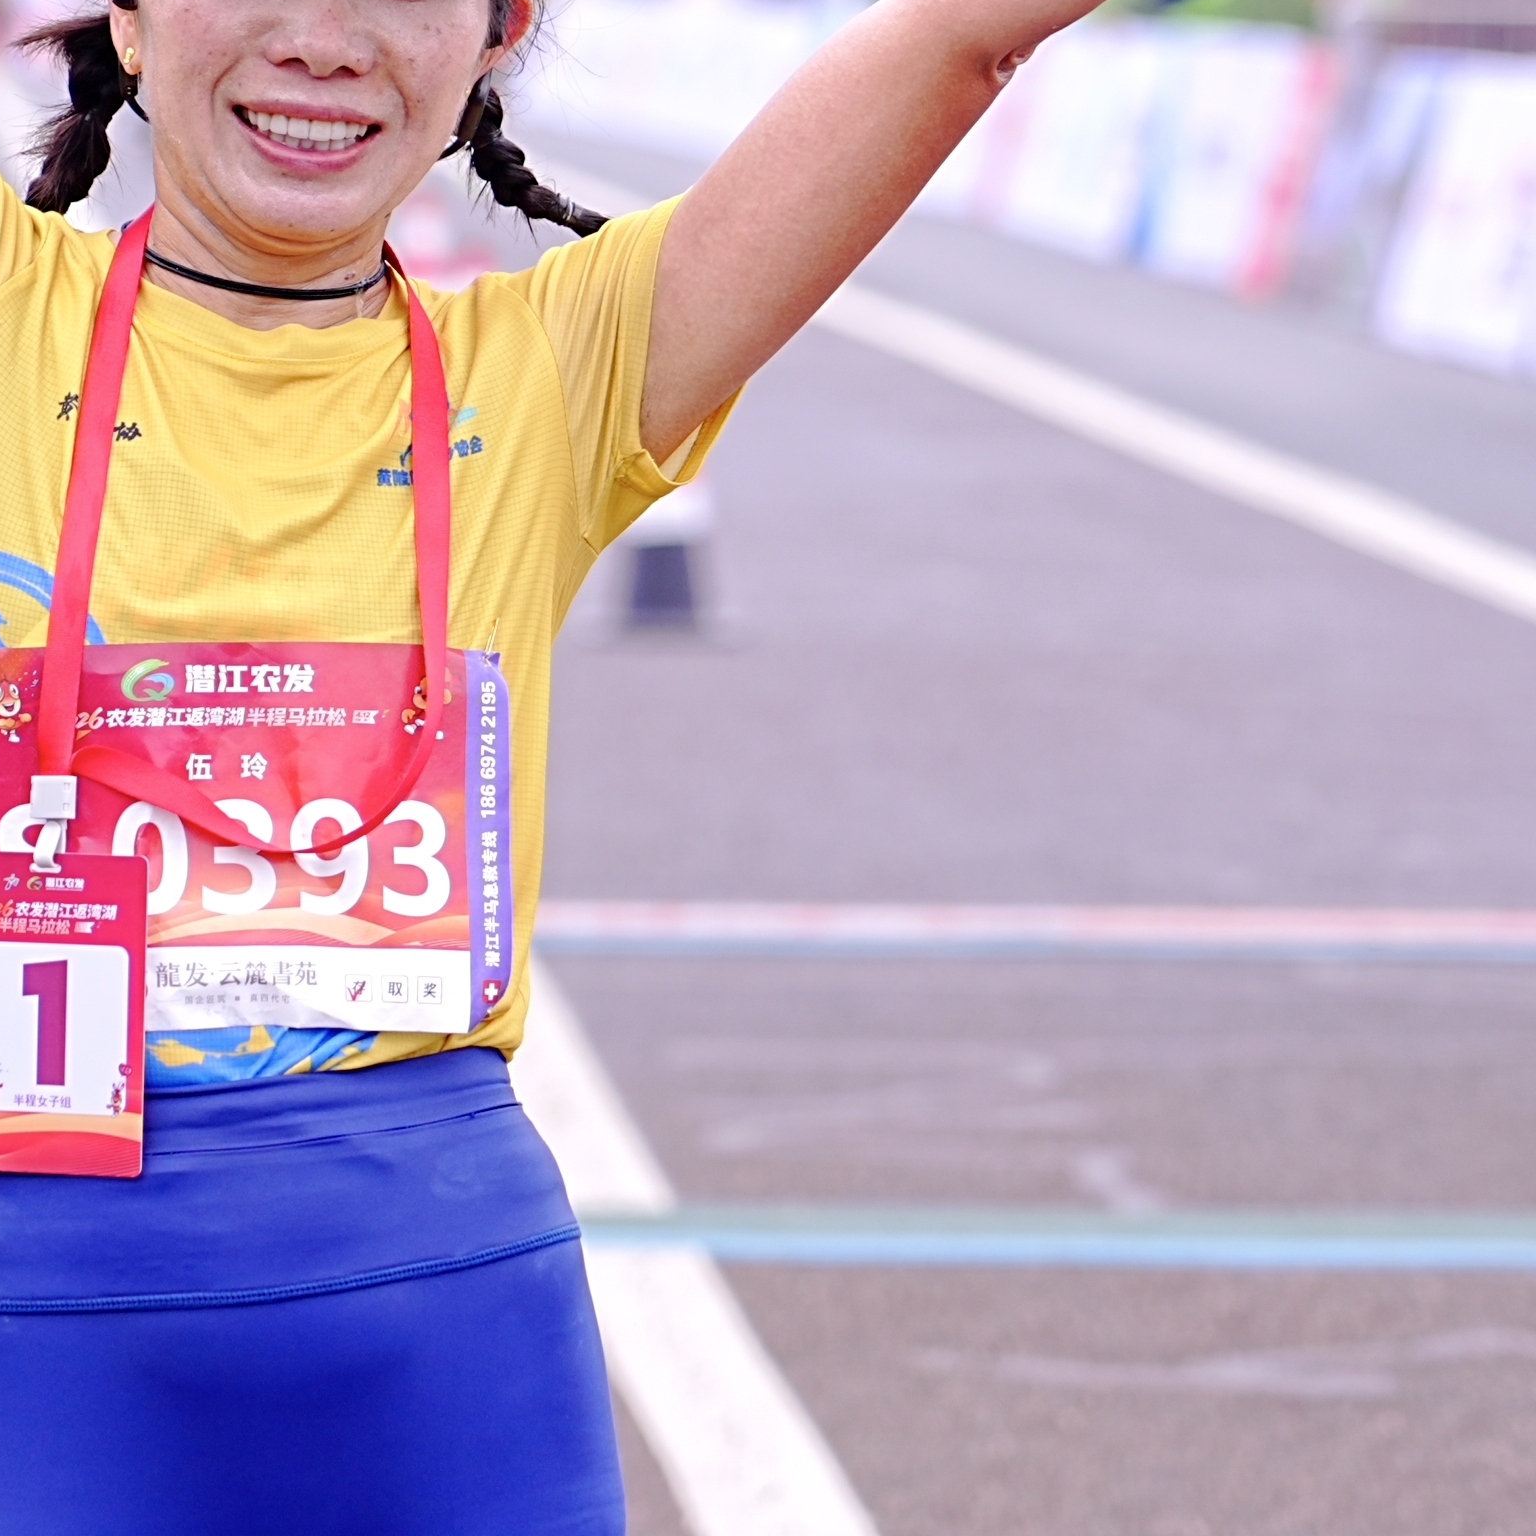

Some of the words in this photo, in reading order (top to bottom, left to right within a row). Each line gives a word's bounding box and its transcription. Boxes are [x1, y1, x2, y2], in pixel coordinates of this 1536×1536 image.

[185, 663, 314, 693] 潜江农发
[480, 681, 497, 728] 2195
[480, 732, 497, 779] 6974
[480, 784, 497, 818] 186
[482, 830, 500, 967] 潜江半马急救专线
[388, 981, 402, 997] 取
[423, 982, 437, 998] 奖
[22, 959, 68, 1086] 1
[13, 1094, 71, 1108] 半程女子组
